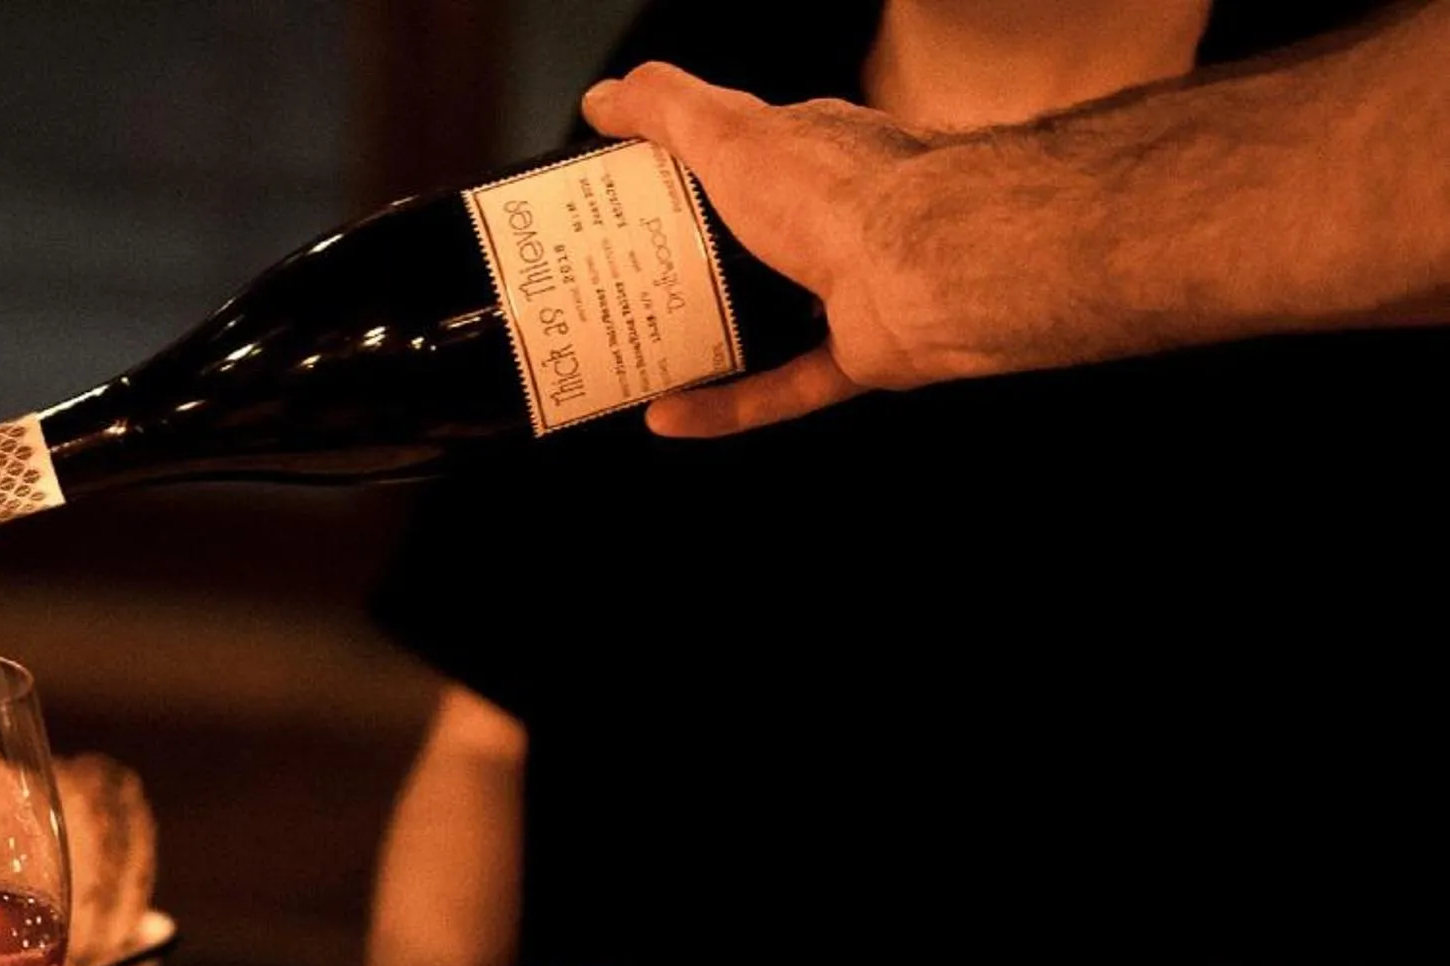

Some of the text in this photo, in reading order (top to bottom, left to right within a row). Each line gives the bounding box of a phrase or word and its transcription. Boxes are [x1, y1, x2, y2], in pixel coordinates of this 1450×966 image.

[502, 199, 557, 303] Thieves
[538, 306, 570, 337] as
[540, 342, 586, 407] Thick
